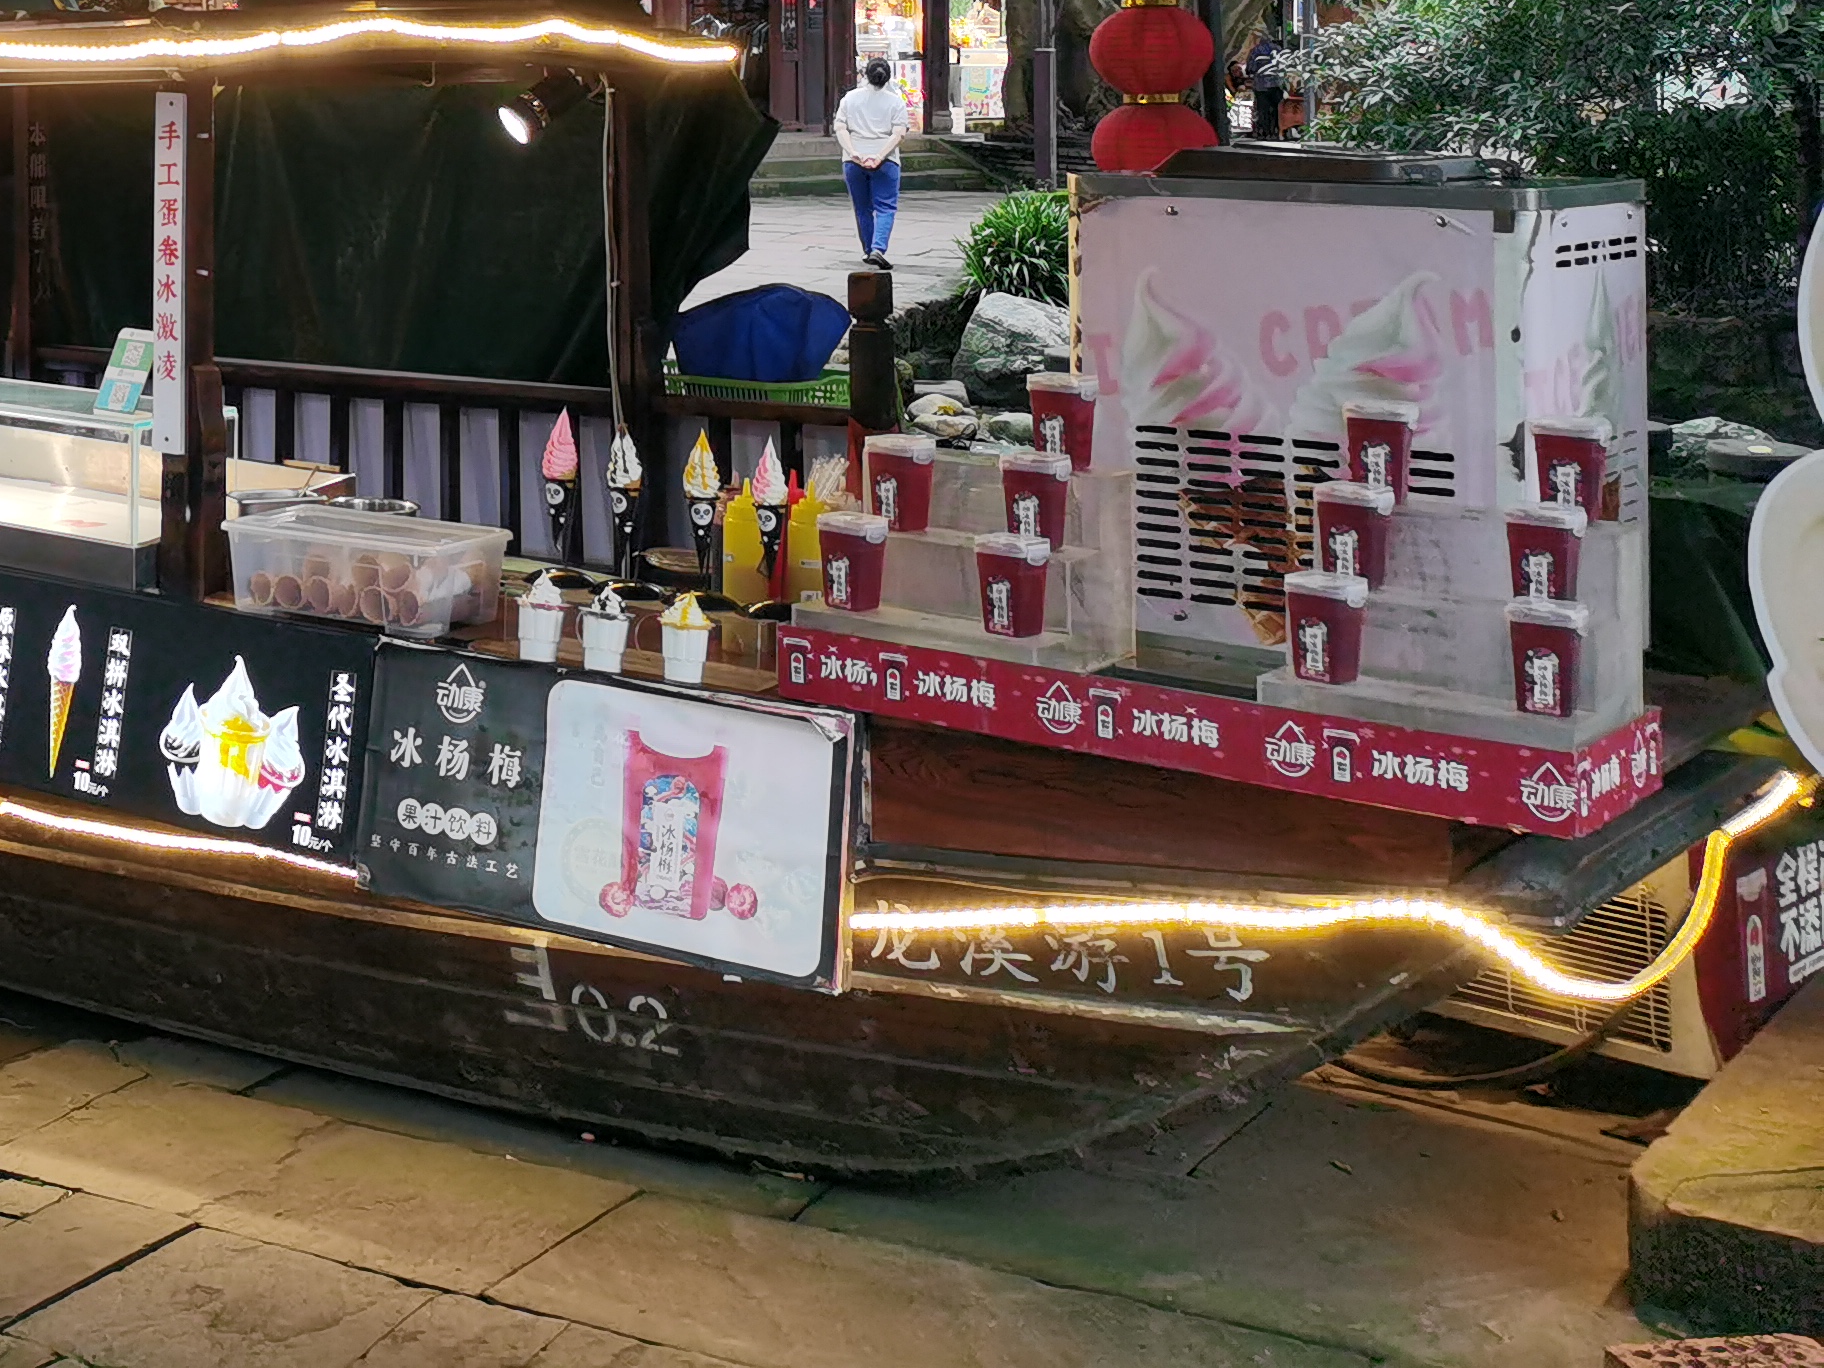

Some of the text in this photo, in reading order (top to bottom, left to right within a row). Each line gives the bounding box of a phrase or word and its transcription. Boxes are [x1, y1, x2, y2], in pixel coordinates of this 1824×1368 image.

[155, 120, 182, 382] 手工蛋卷冰激凌
[93, 633, 131, 777] 双拼冰淇淋
[436, 682, 485, 713] 动康
[317, 673, 356, 831] 圣代冰淇淋
[390, 727, 523, 788] 冰杨梅
[820, 654, 1578, 813] 冰杨 冰杨梅 动康 冰杨梅 动康 冰杨梅 动康
[403, 803, 492, 840] 果汁饮料
[370, 834, 519, 879] 坚守百年古法工艺
[1776, 839, 1824, 908] 全程
[1780, 896, 1824, 963] 不添
